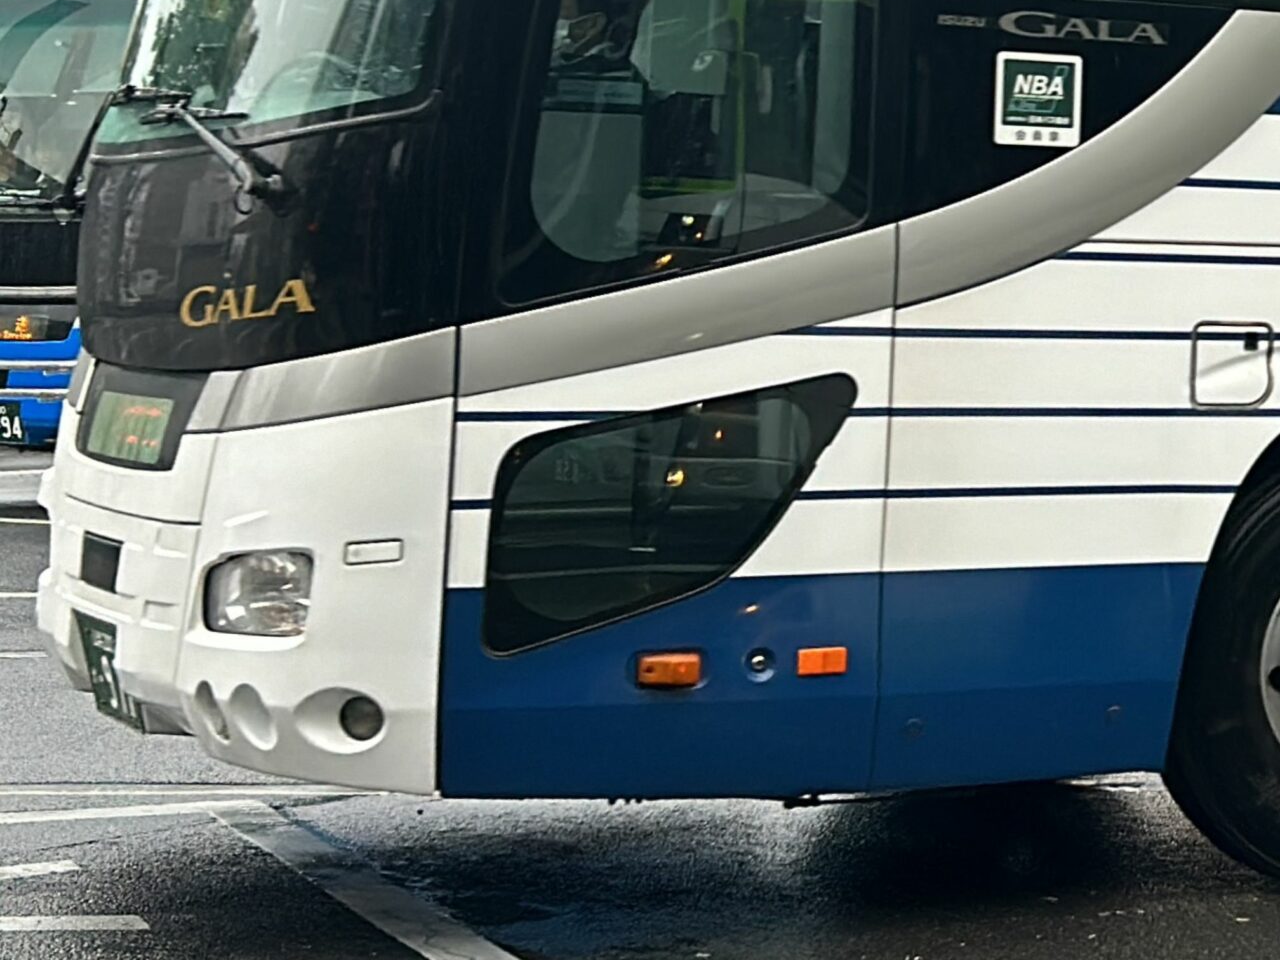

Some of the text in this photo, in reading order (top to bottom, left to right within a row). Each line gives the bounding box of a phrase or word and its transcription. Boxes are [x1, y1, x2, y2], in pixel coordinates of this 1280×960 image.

[998, 10, 1168, 45] GALA
[1013, 74, 1064, 96] NBA
[180, 278, 315, 327] GALA
